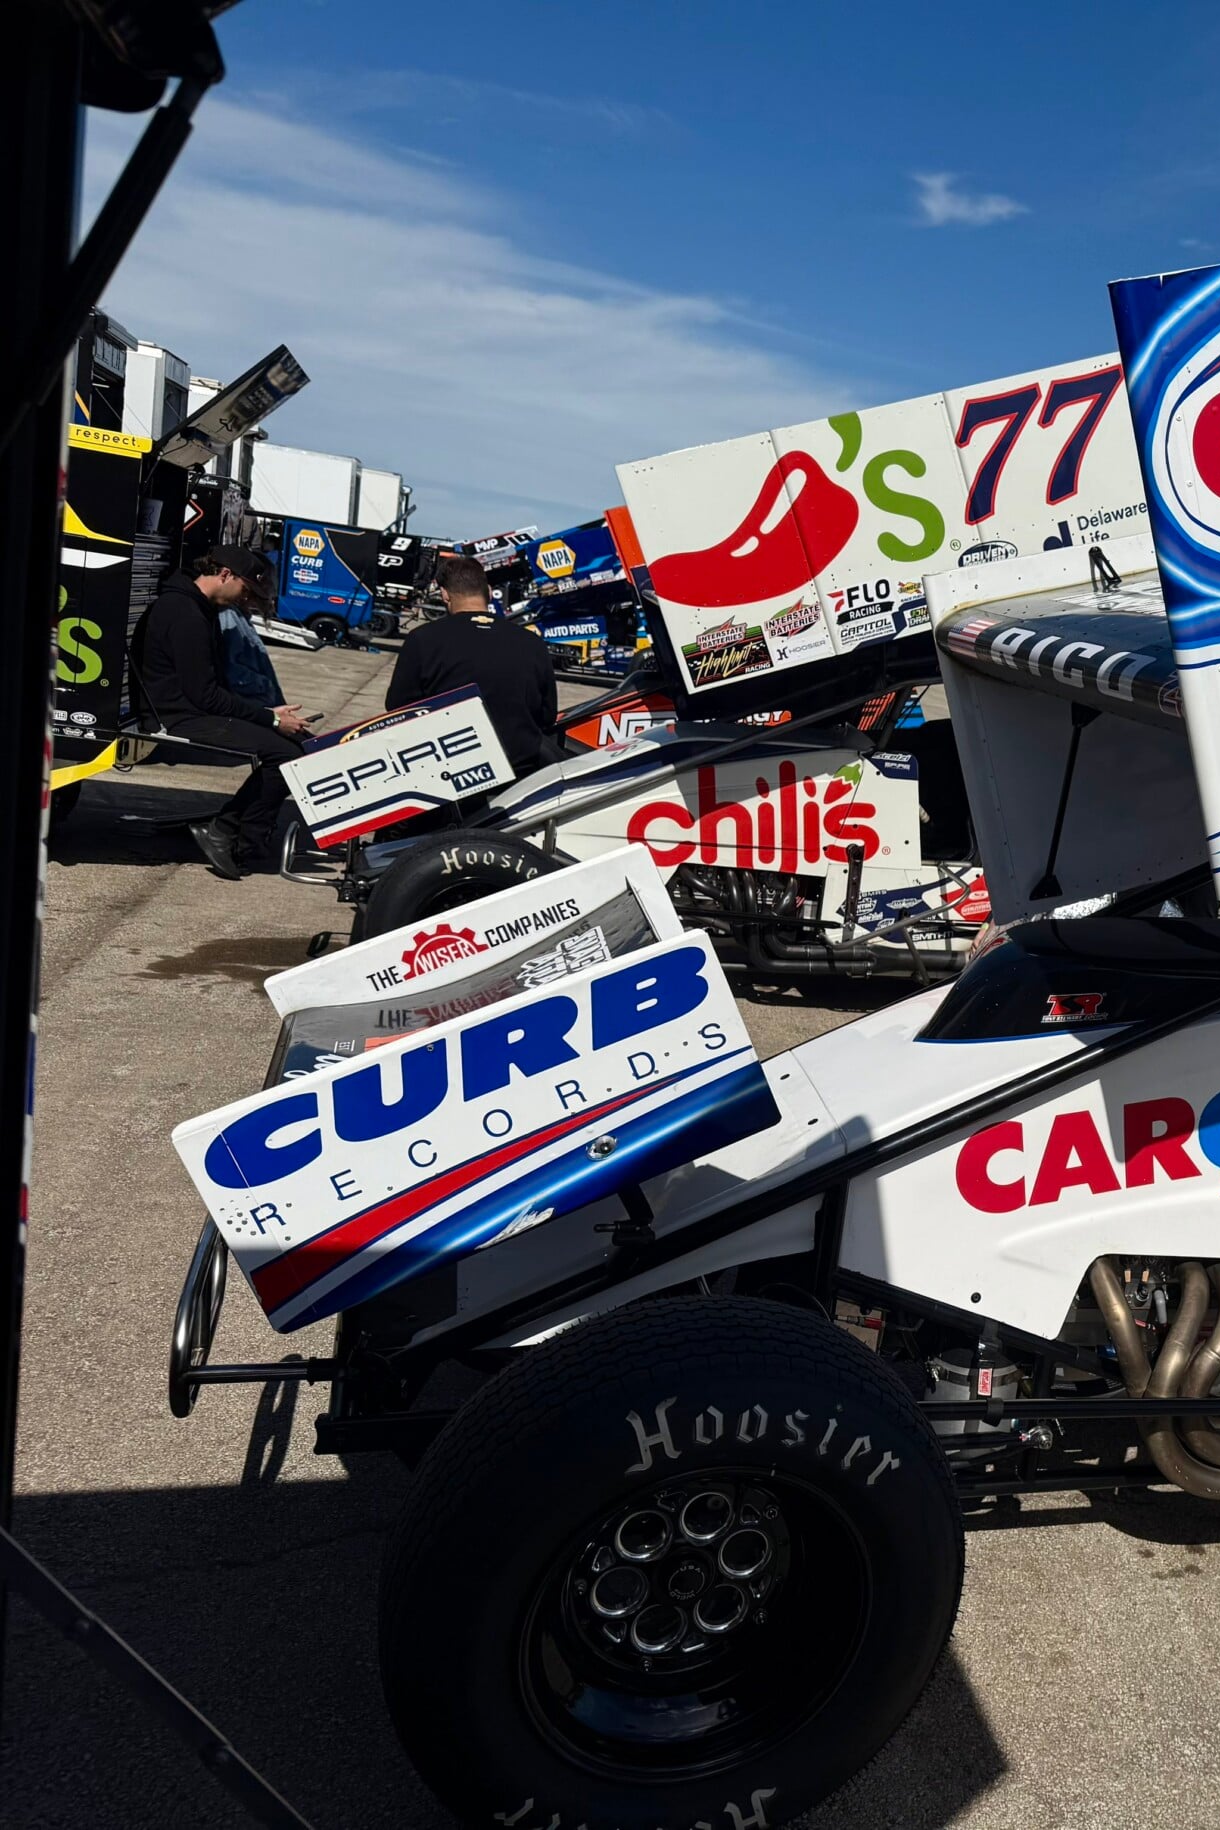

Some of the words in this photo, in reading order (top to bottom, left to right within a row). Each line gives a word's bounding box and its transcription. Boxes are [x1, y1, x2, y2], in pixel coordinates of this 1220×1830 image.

[75, 427, 141, 448] respect.
[955, 364, 1124, 525] 77
[1077, 502, 1148, 530] Delaware
[298, 537, 320, 551] NAPA
[474, 538, 499, 552] MVP
[291, 555, 324, 568] CURB
[541, 549, 572, 569] NAPA
[846, 579, 890, 609] FLO
[767, 605, 821, 628] INTERSTATE
[849, 604, 881, 620] RACING
[544, 626, 568, 638] AUTO
[569, 623, 599, 636] PARTS
[699, 626, 744, 642] INTERSTATE
[770, 613, 820, 637] BATTERIES
[840, 618, 892, 638] CAPITOL
[702, 634, 744, 649] BATTERIES
[744, 662, 771, 674] RACING
[990, 627, 1157, 702] RICO
[306, 726, 483, 806] SPIRE
[453, 764, 495, 790] TWG
[440, 846, 539, 881] Hoosie
[484, 898, 580, 948] COMPANIES
[416, 940, 477, 975] WISER
[366, 965, 403, 992] THE
[205, 946, 710, 1189] CURB
[251, 1022, 727, 1236] RECORDS
[622, 1396, 902, 1487] Hoosier
